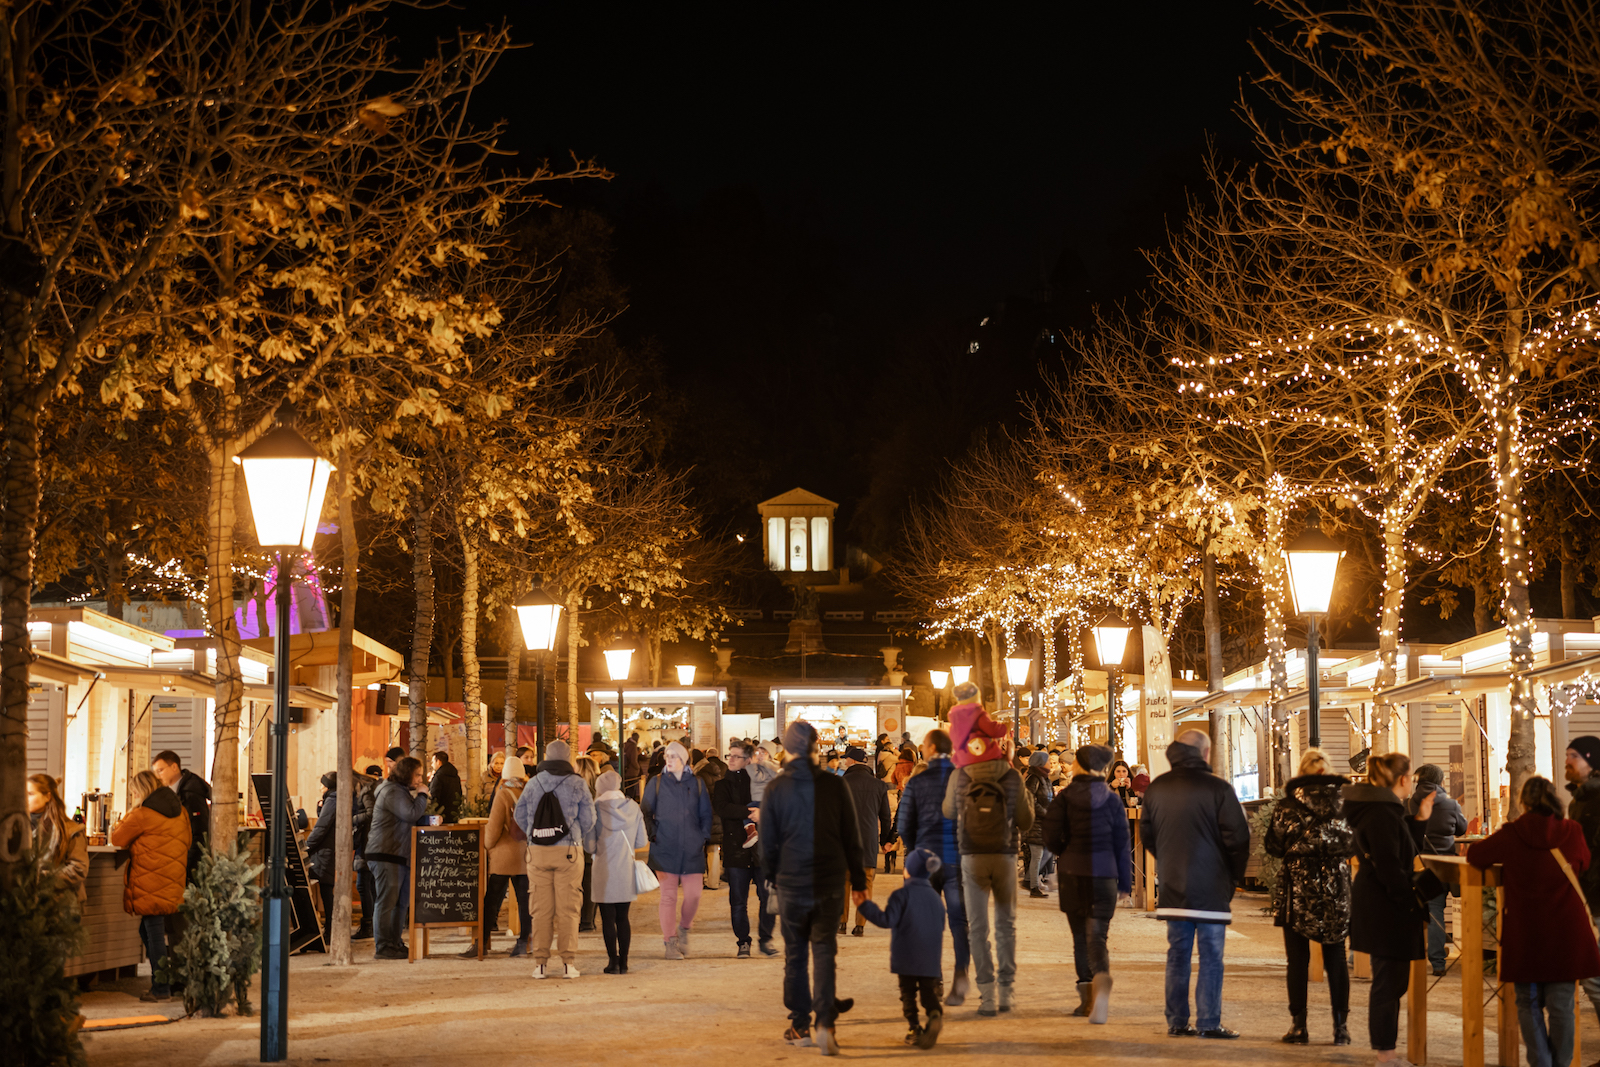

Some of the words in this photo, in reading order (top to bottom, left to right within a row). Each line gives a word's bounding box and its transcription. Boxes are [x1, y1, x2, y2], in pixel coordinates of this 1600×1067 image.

[532, 828, 556, 838] PUMA
[423, 901, 450, 915] Orange
[455, 901, 474, 912] 3,50
